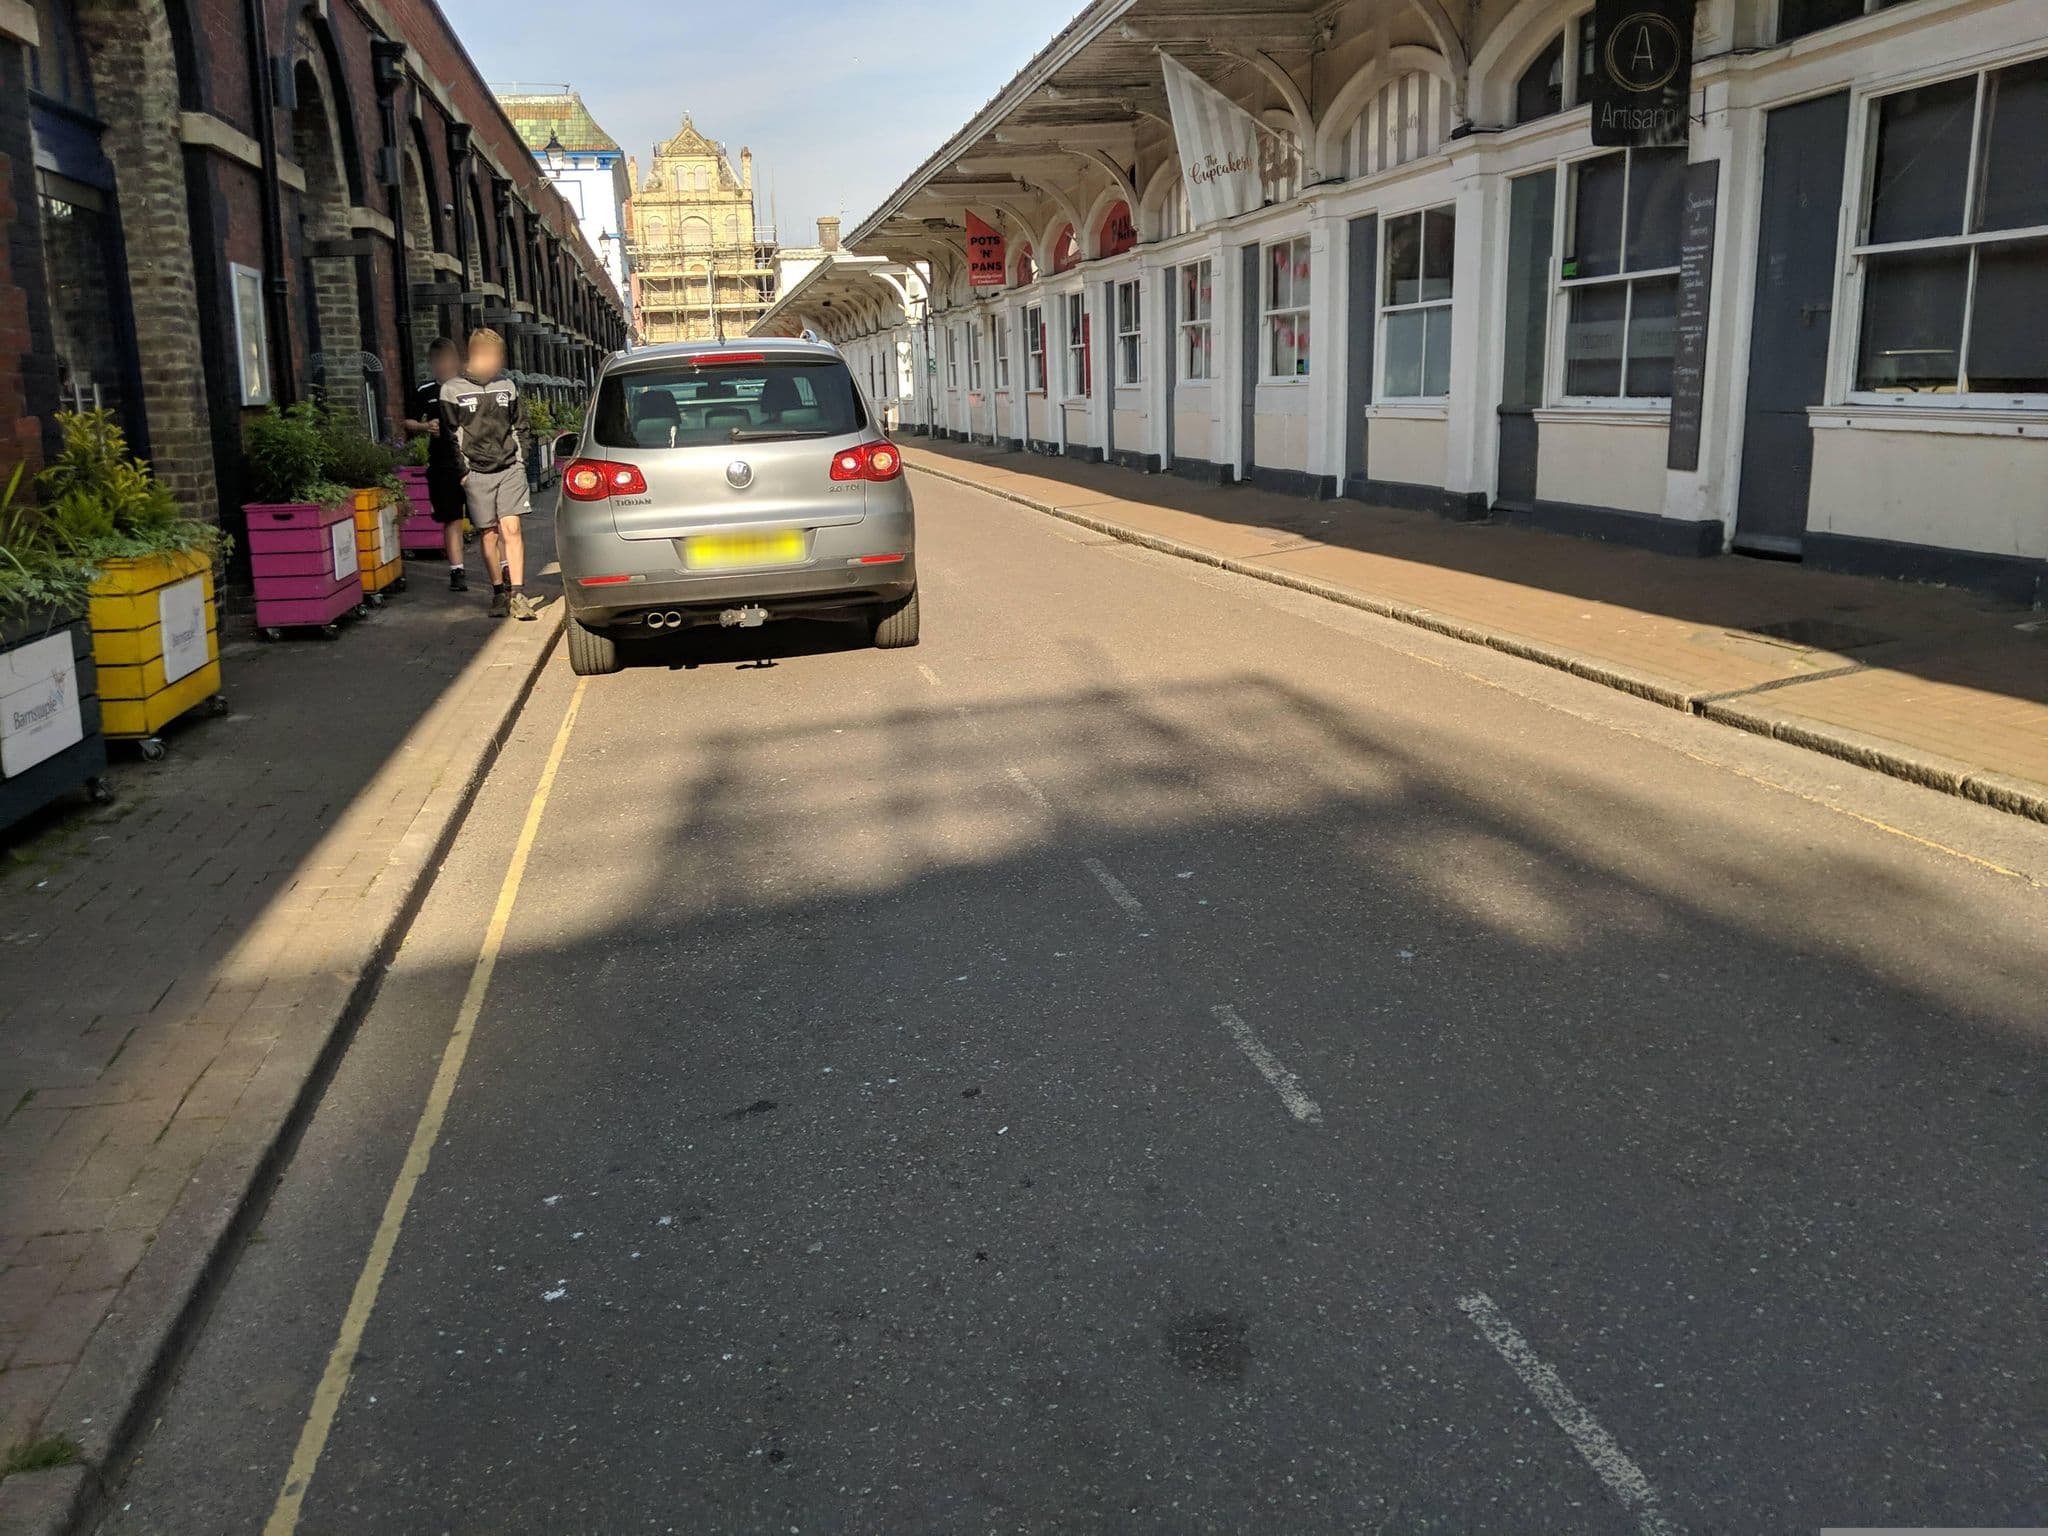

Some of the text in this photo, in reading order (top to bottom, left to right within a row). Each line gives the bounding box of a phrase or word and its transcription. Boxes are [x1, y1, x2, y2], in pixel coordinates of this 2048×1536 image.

[1631, 25, 1654, 71] A
[1203, 153, 1218, 167] The
[970, 235, 1001, 246] POTS
[971, 261, 1003, 272] PANS
